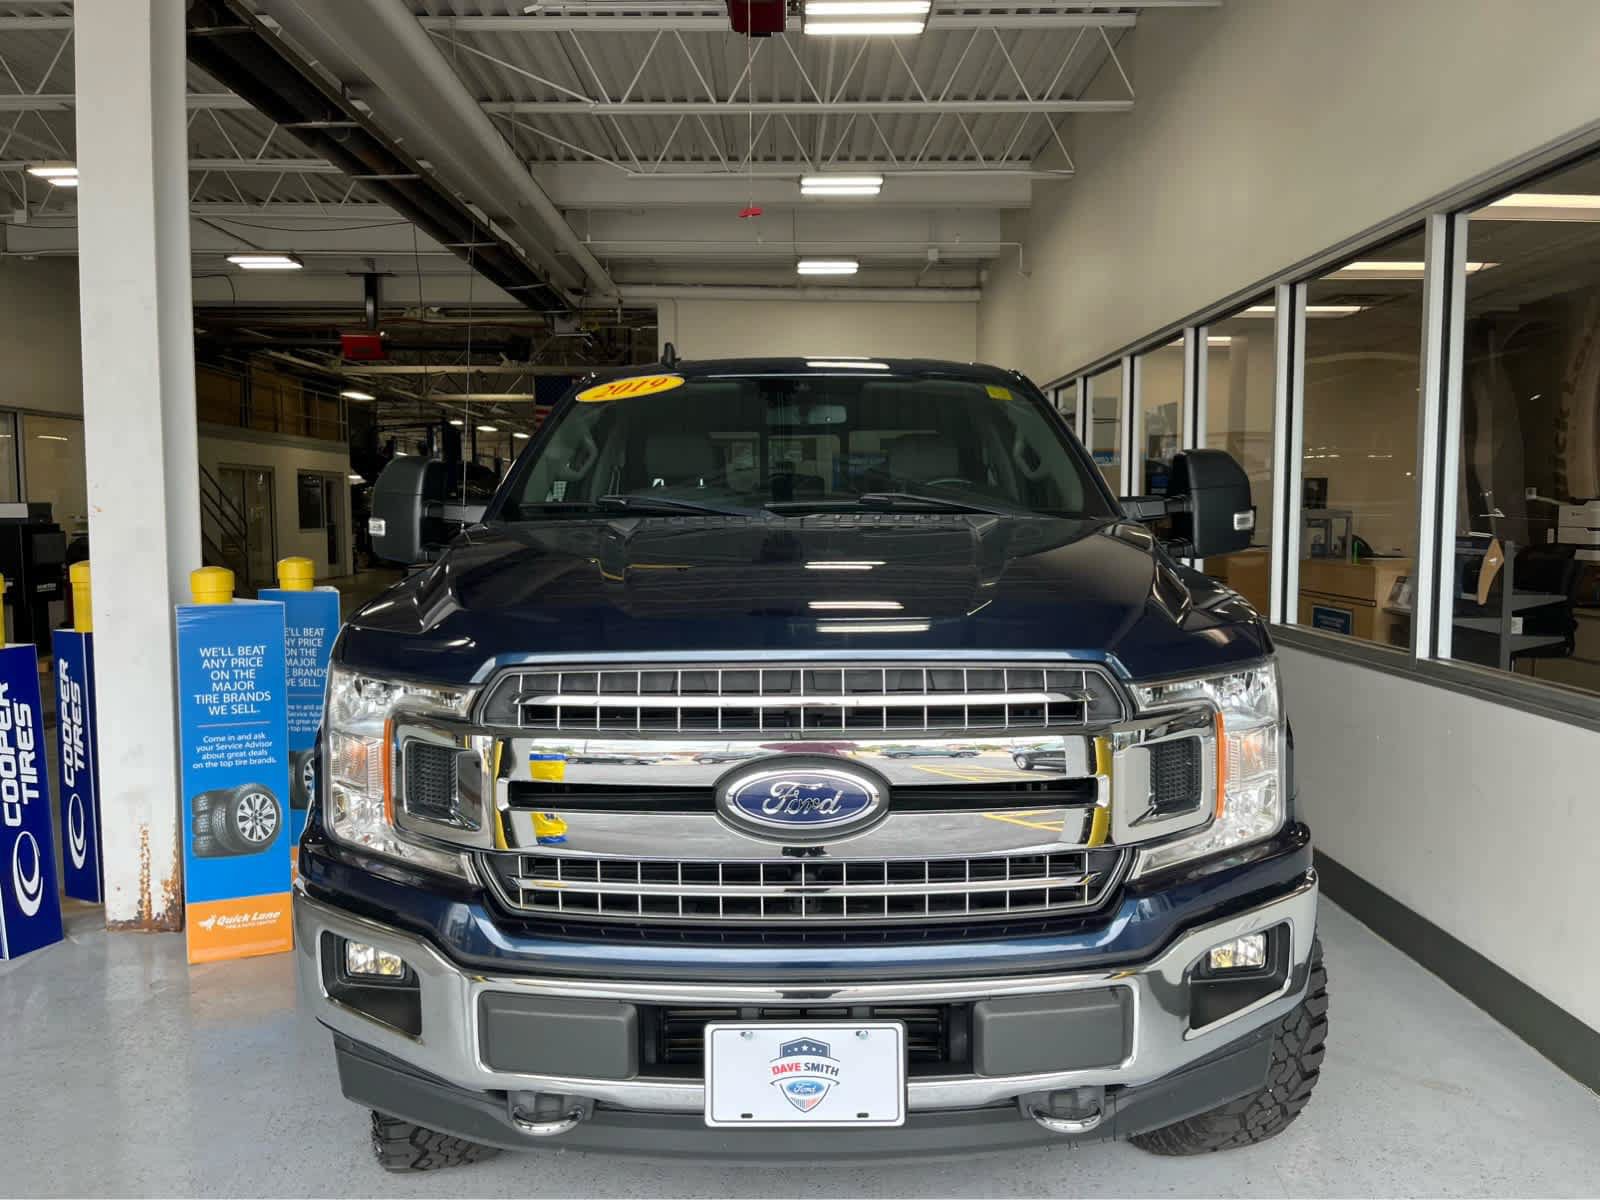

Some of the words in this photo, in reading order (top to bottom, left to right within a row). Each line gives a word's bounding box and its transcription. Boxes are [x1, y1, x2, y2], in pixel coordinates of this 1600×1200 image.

[594, 377, 669, 399] 2019
[285, 627, 301, 637] E'LL
[303, 627, 325, 637] BEAT
[285, 638, 296, 647] NY
[298, 638, 323, 647] PRICE
[199, 647, 234, 658] WE'LL
[238, 645, 267, 656] BEAT
[301, 647, 317, 656] THE
[202, 658, 228, 670] ANY
[231, 657, 264, 668] PRICE
[211, 670, 230, 681] ON
[232, 669, 256, 679] THE
[212, 681, 255, 692] MAJOR
[194, 694, 219, 704] TIRE
[223, 691, 272, 703] BRANDS
[208, 705, 228, 716] WE
[231, 703, 261, 714] SELL.
[59, 658, 75, 788] COOPER
[71, 680, 86, 772] TIRES
[203, 735, 226, 743] Come
[228, 734, 236, 742] in
[237, 733, 252, 741] and
[253, 732, 266, 740] ask
[13, 702, 40, 805] TIRES
[196, 745, 213, 754] your
[215, 742, 242, 751] Service
[245, 740, 273, 749] Advisor
[202, 751, 225, 760] about
[227, 750, 246, 760] great
[248, 748, 268, 757] deals
[205, 760, 218, 768] the
[220, 760, 233, 769] top
[235, 759, 247, 767] tire
[762, 781, 844, 815] Ford
[216, 913, 251, 926] Quick
[251, 911, 281, 921] Lane
[772, 1062, 801, 1076] DAVE
[803, 1062, 840, 1077] SMITH
